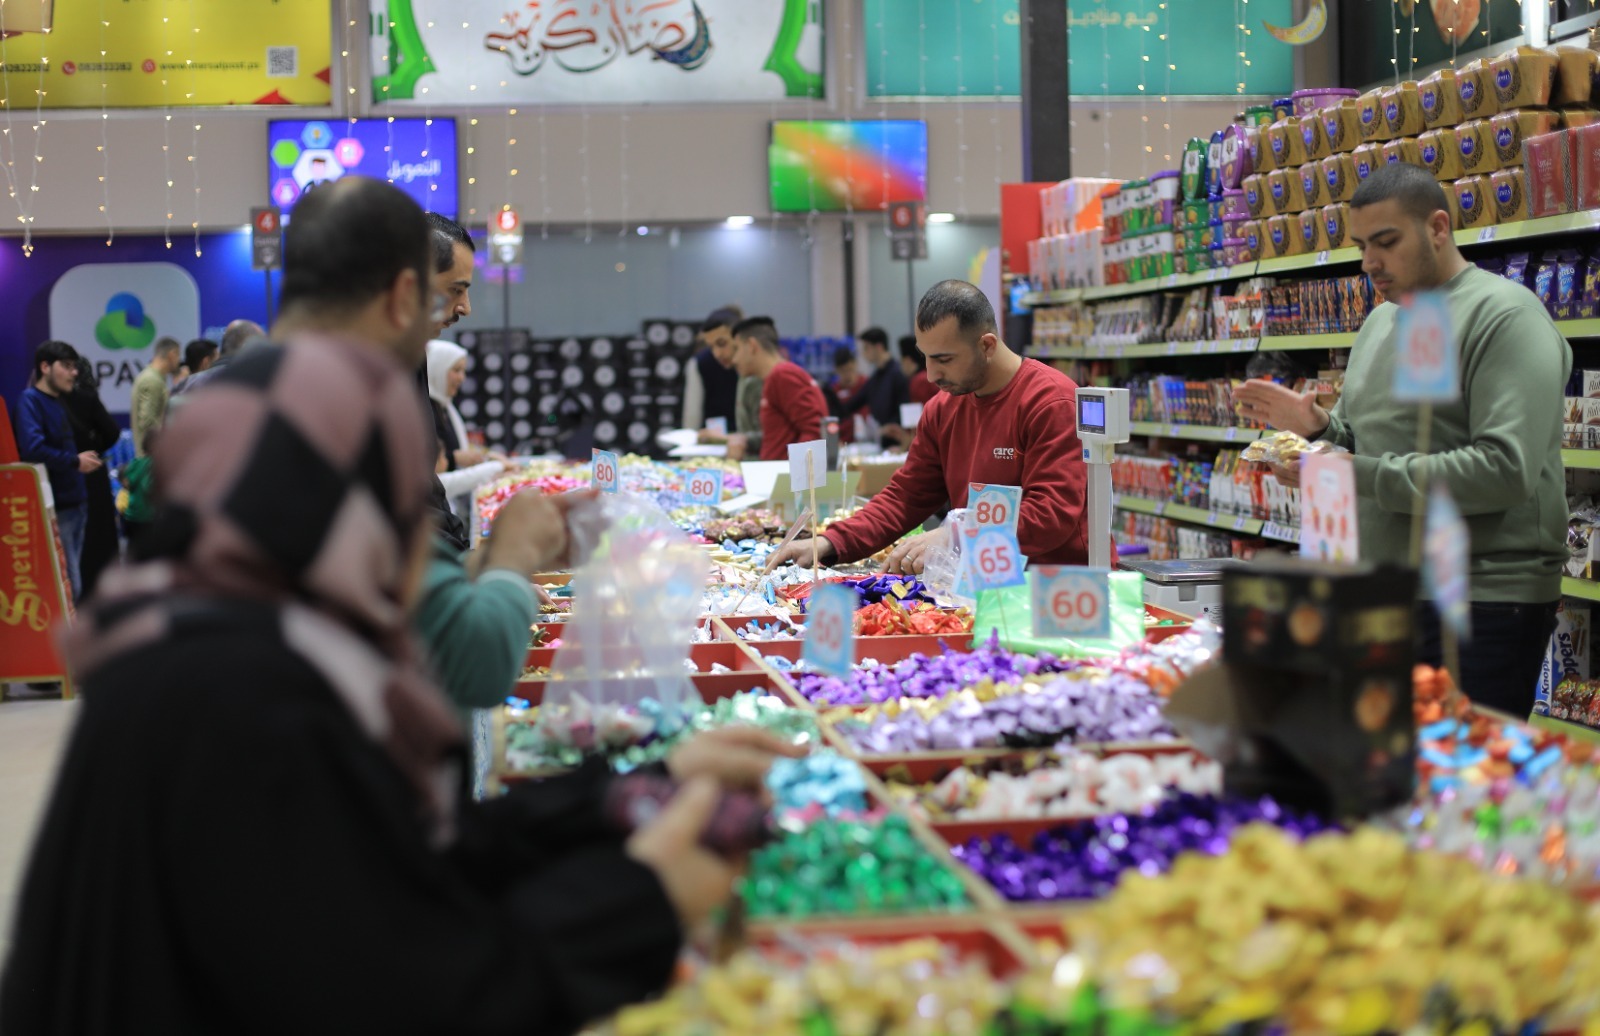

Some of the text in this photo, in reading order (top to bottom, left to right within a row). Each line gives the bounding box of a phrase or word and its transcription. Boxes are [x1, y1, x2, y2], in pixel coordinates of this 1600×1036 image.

[260, 212, 276, 231] 4
[993, 447, 1014, 456] care
[596, 463, 614, 482] 80
[691, 480, 714, 496] 80
[976, 501, 1007, 525] 80
[979, 546, 1011, 574] 65
[1052, 590, 1098, 619] 60
[1558, 632, 1580, 676] ppers
[1541, 656, 1550, 695] Knopp
